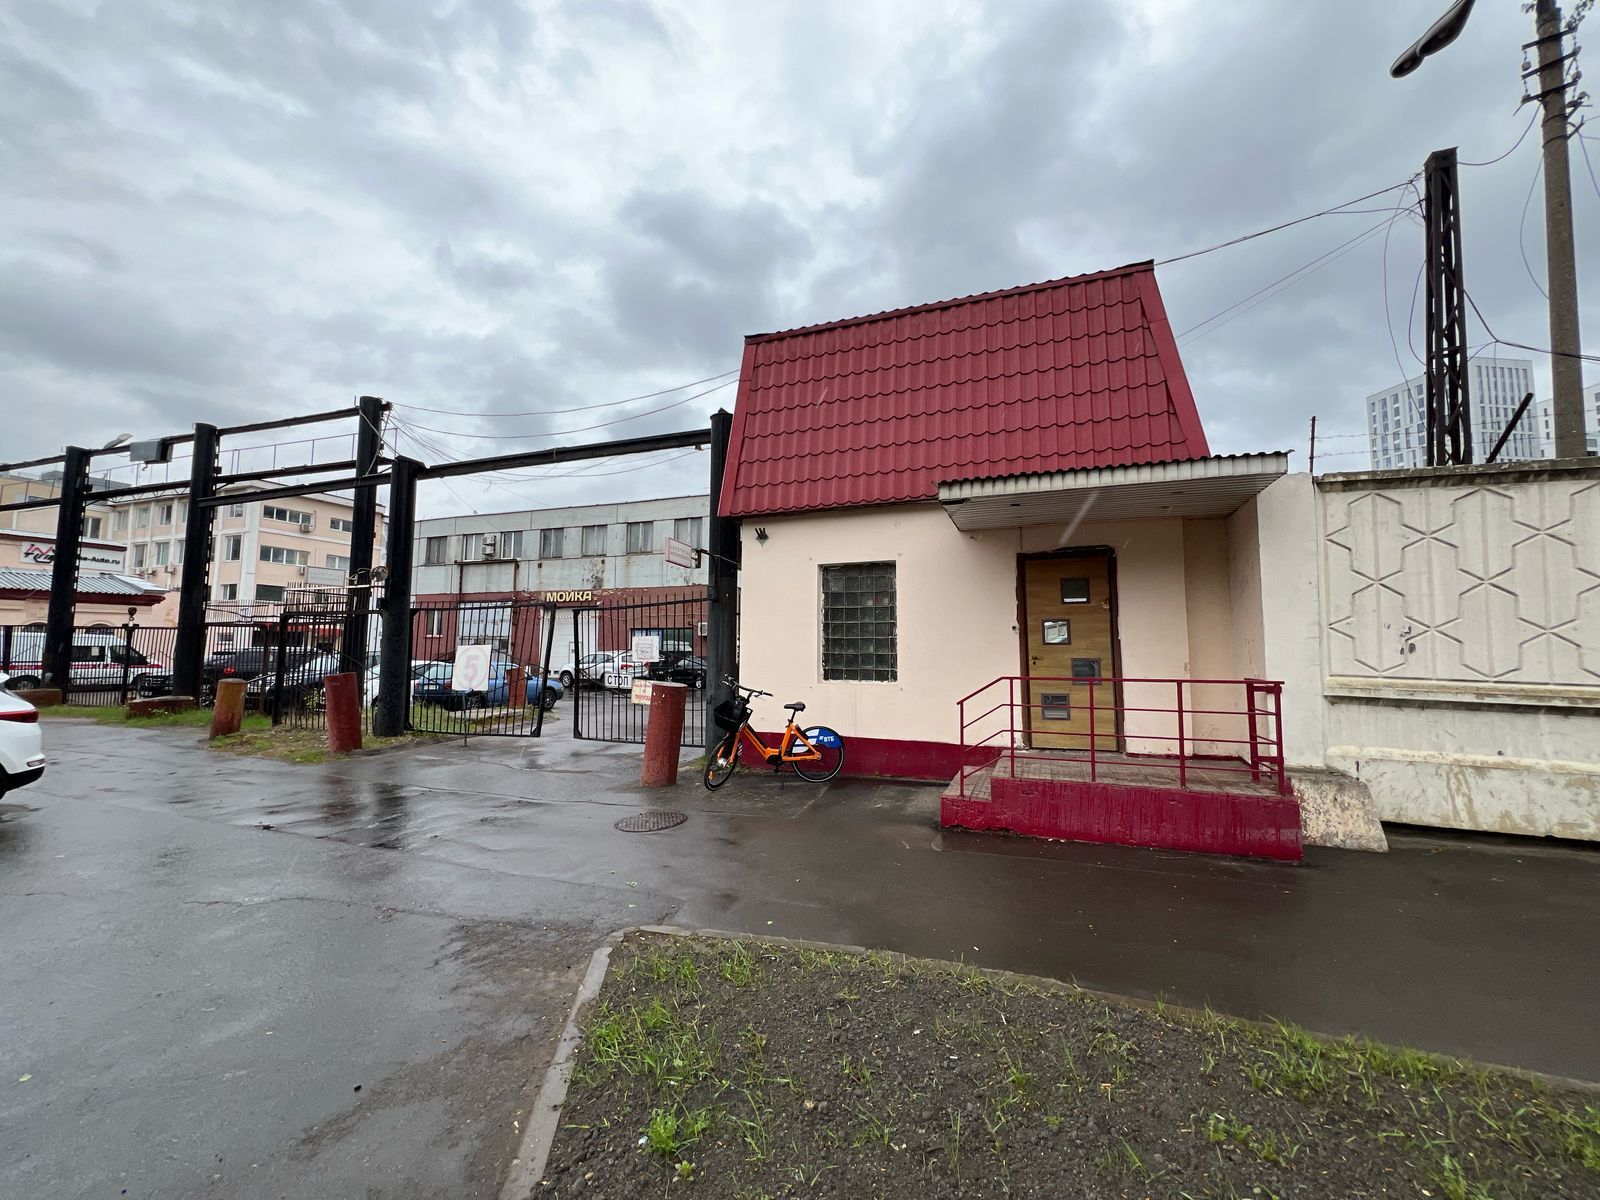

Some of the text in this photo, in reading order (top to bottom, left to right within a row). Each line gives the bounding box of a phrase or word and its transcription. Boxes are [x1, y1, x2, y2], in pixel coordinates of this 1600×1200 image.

[546, 589, 592, 602] МОЙКА
[463, 654, 479, 681] 5
[607, 675, 629, 686] СТОП
